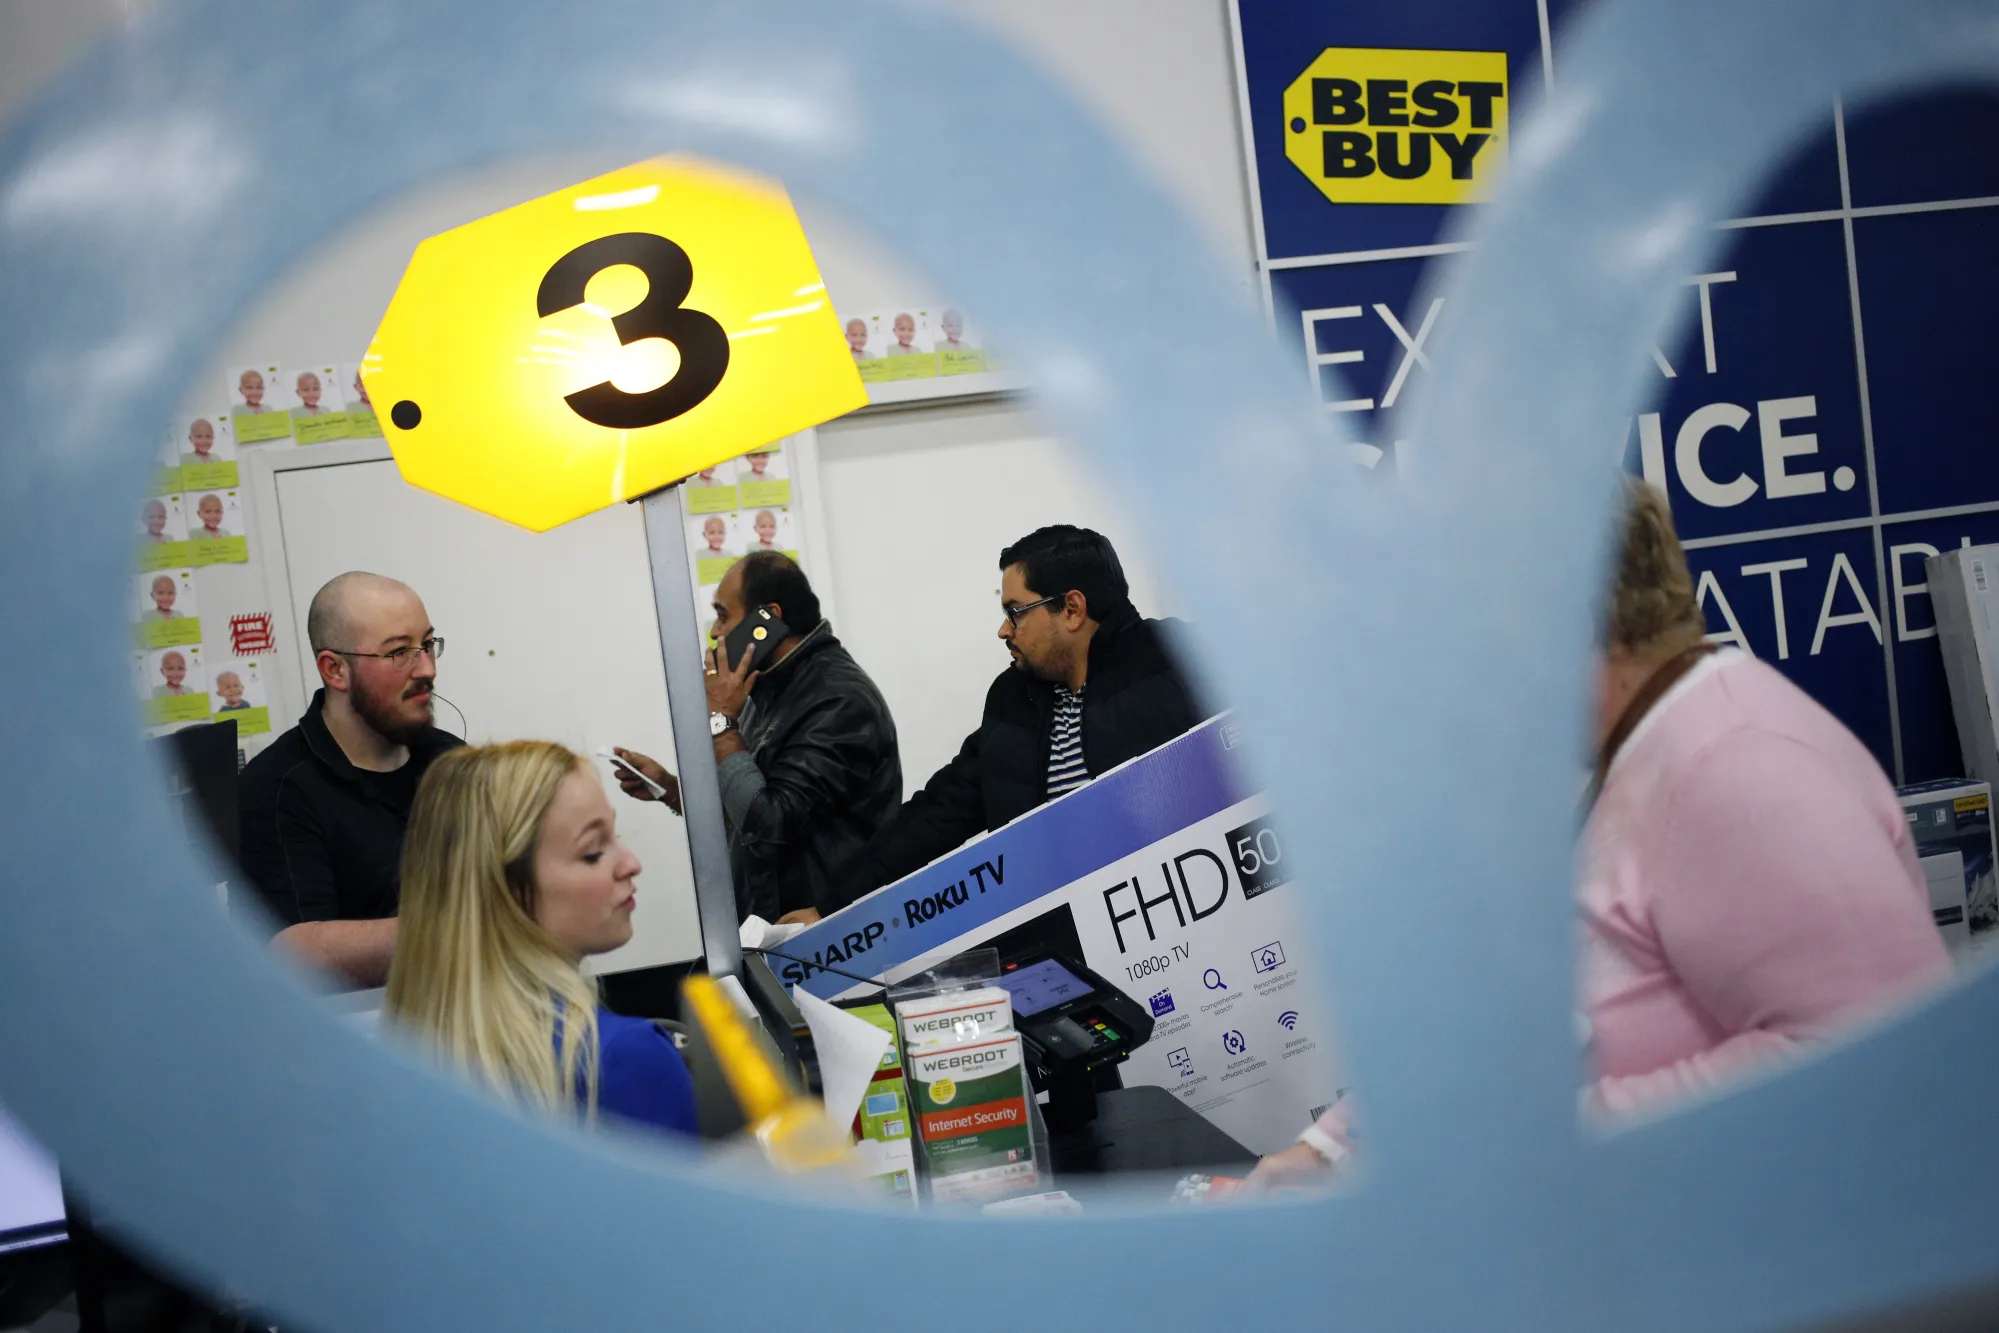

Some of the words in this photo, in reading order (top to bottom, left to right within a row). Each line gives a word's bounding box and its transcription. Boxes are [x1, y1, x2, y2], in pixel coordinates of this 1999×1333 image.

[1312, 77, 1503, 128] BEST
[1323, 131, 1491, 180] BUY
[537, 232, 730, 429] 3
[237, 620, 264, 632] FIRE
[1103, 848, 1229, 954] FHD
[1237, 829, 1282, 875] 50
[782, 921, 885, 989] SHARP
[968, 853, 1004, 894] TV
[1125, 954, 1170, 982] 1080p
[1171, 942, 1190, 963] TV
[1200, 991, 1243, 1012] Comprehensive
[1260, 985, 1276, 997] Home
[1170, 1013, 1190, 1024] movies
[1281, 1042, 1316, 1060] connectivity
[1284, 1036, 1308, 1049] Wireless
[923, 1048, 1008, 1073] WEBROOT
[1220, 1069, 1244, 1082] software
[1243, 1060, 1267, 1075] updates
[1226, 1055, 1256, 1071] Automatic
[1189, 1074, 1208, 1087] mobile
[929, 1115, 973, 1133] Internet
[974, 1107, 1018, 1125] Security
